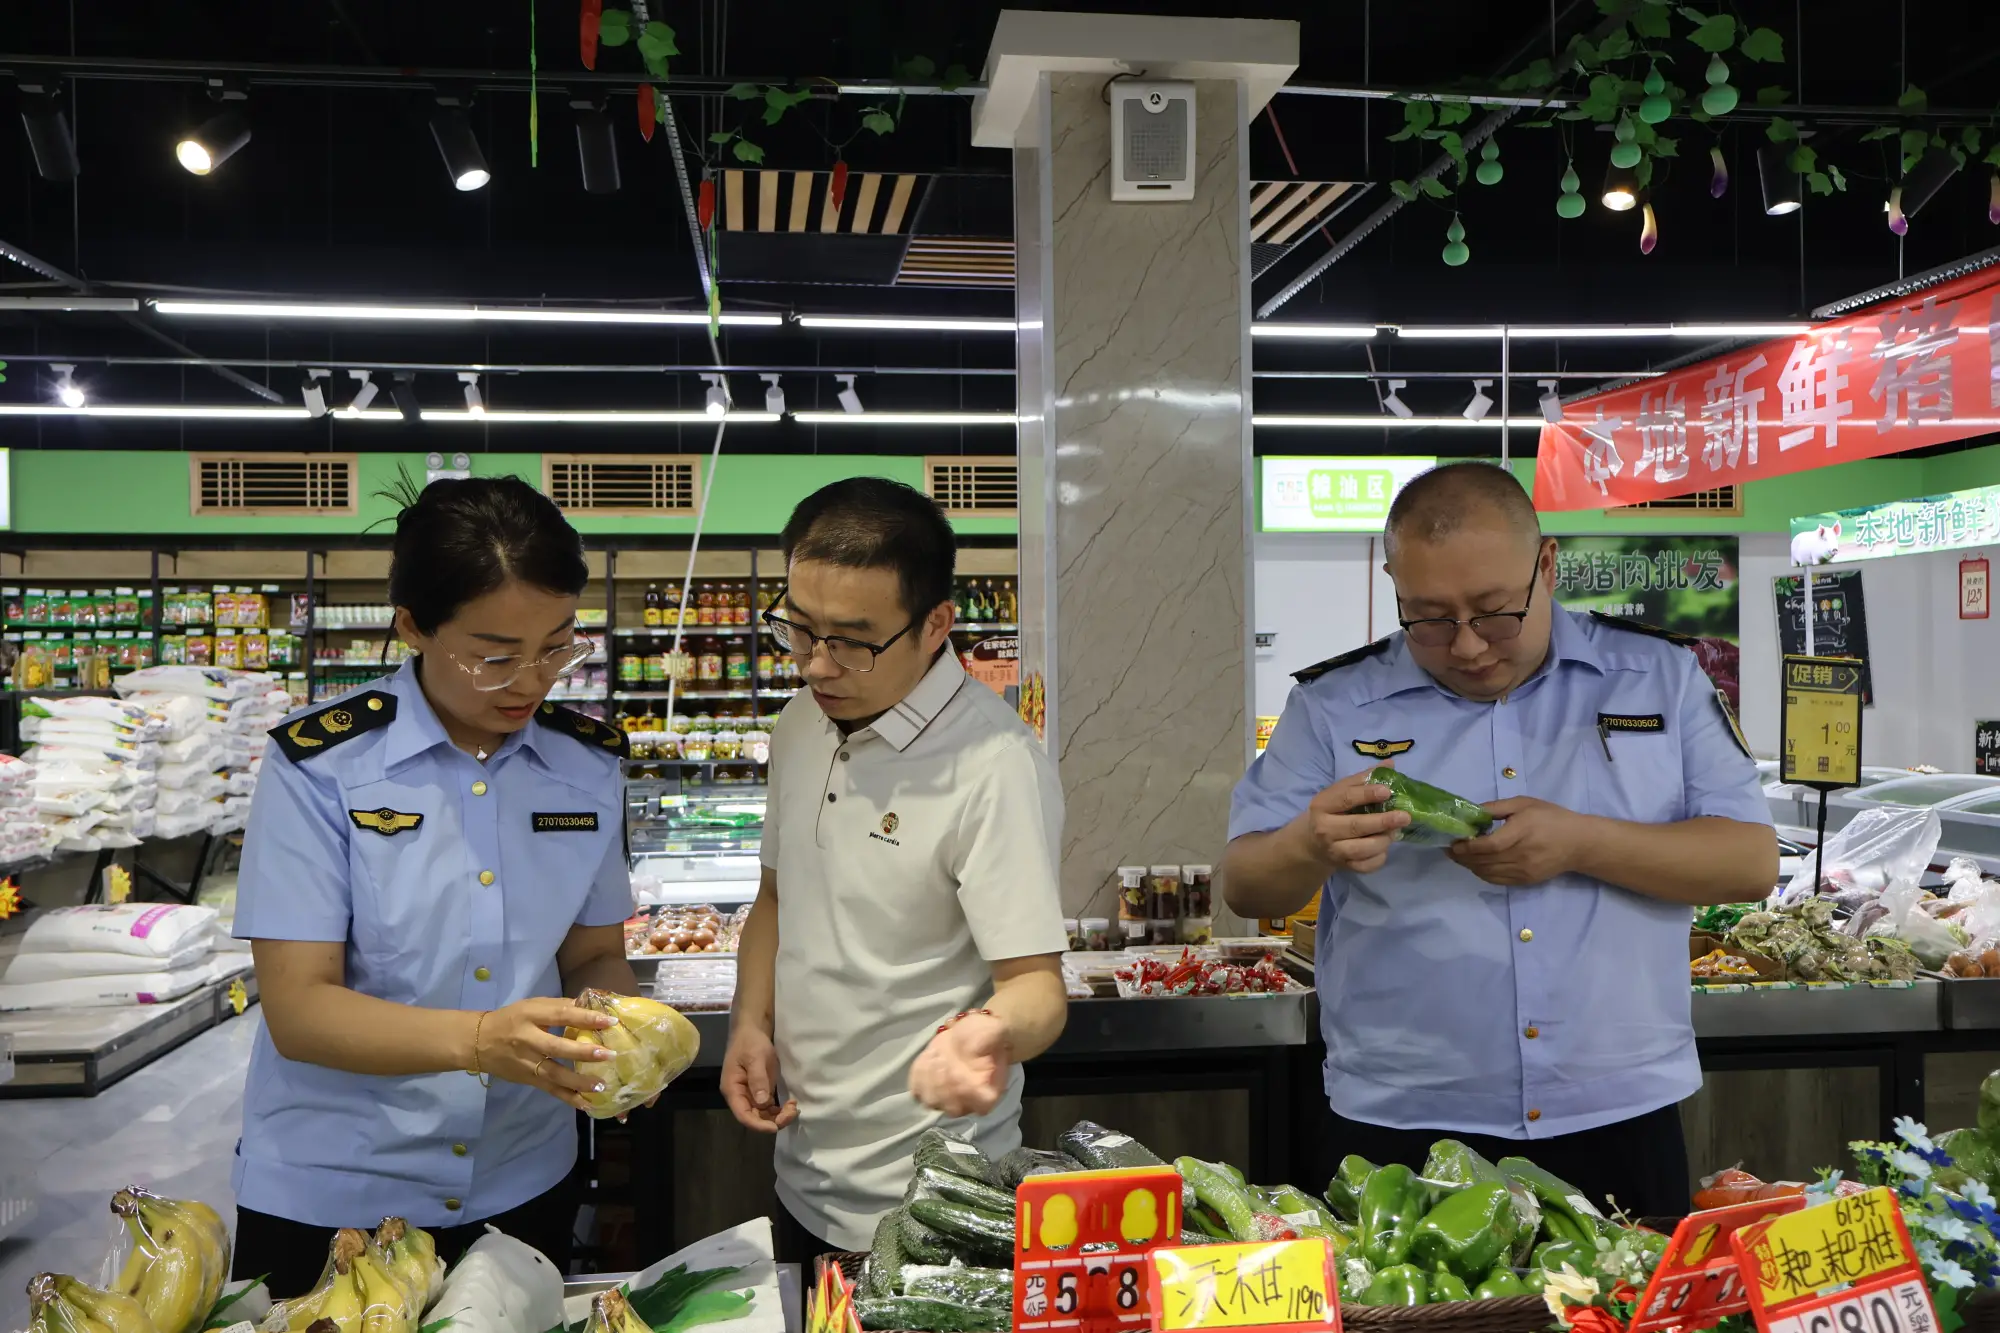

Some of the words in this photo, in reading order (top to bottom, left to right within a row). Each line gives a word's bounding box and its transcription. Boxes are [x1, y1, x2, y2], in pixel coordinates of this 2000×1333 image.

[1580, 292, 2000, 496] 本地新鲜猪
[1312, 473, 1385, 499] 粮油区
[983, 639, 1018, 651] 在家吃火
[1792, 664, 1833, 685] 促销
[1845, 745, 1857, 757] 元
[538, 817, 595, 826] 27070330456
[1835, 1192, 1881, 1227] 6134
[1176, 1252, 1283, 1323] 沃柑
